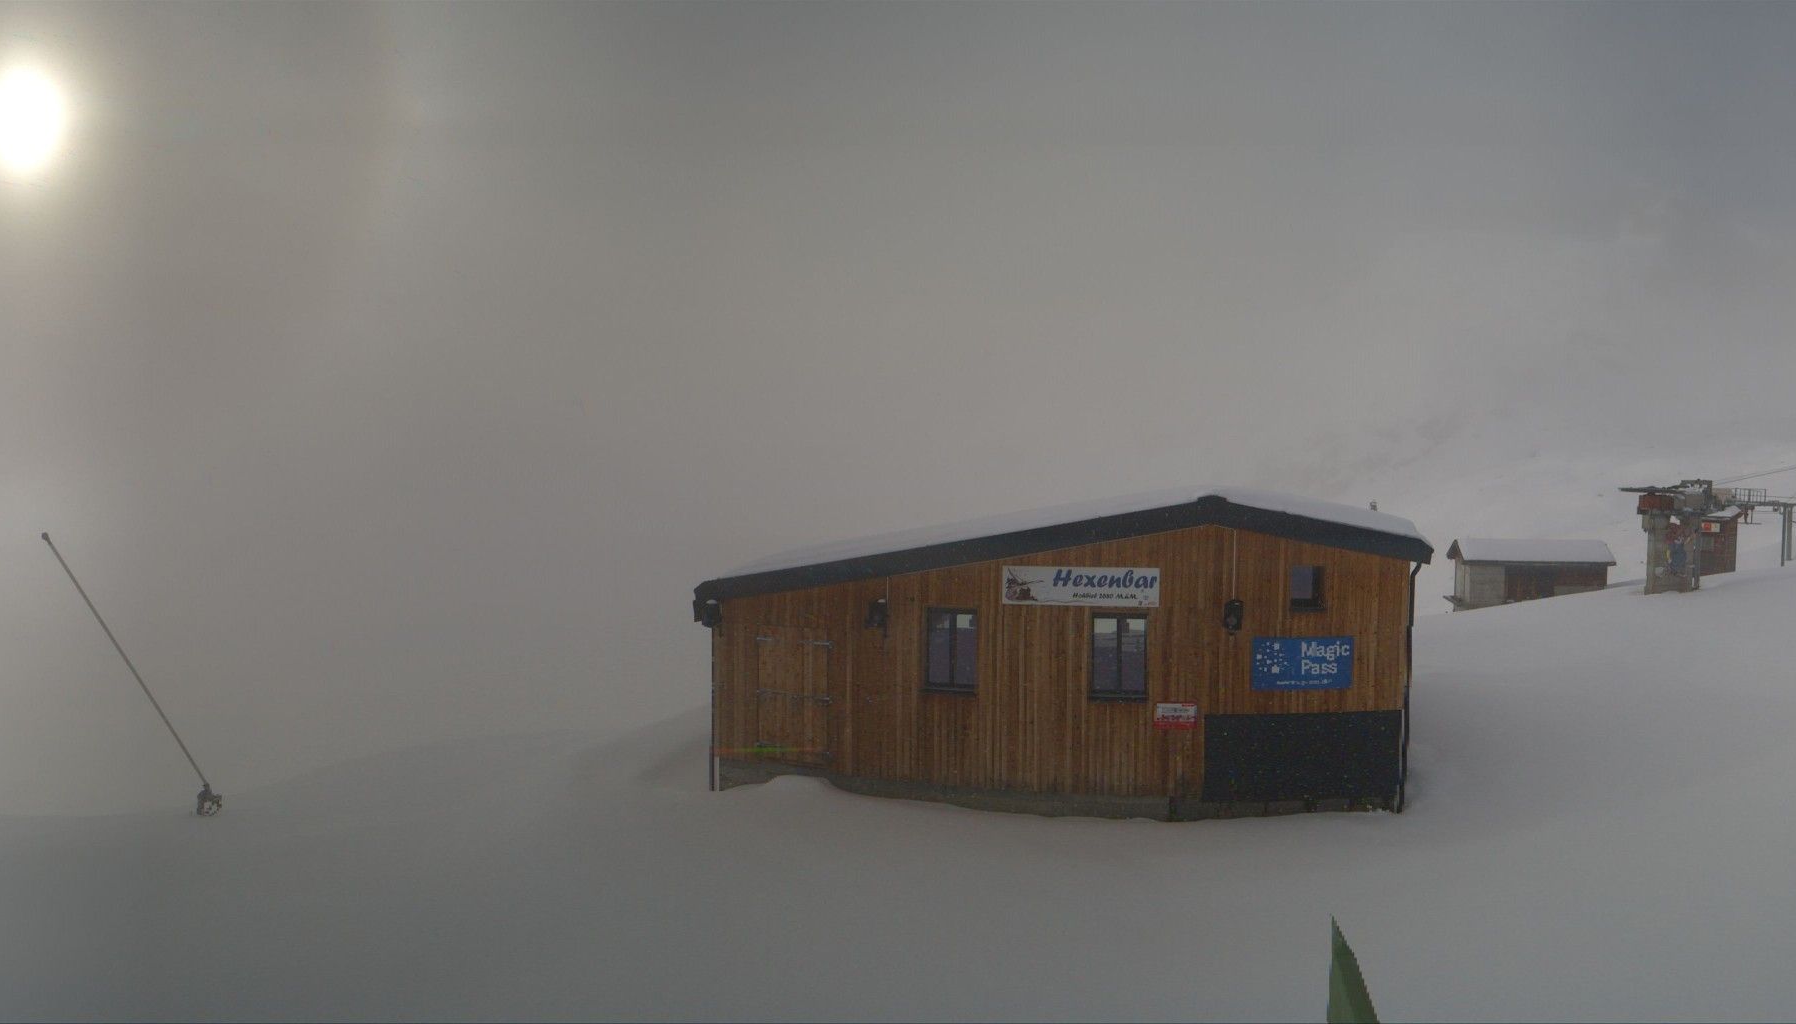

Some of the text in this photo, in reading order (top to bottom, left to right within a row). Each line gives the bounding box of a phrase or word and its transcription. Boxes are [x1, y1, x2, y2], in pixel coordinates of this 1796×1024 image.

[1053, 568, 1157, 589] Hexenbar
[1301, 640, 1350, 661] Magic
[1301, 660, 1338, 675] Pass
